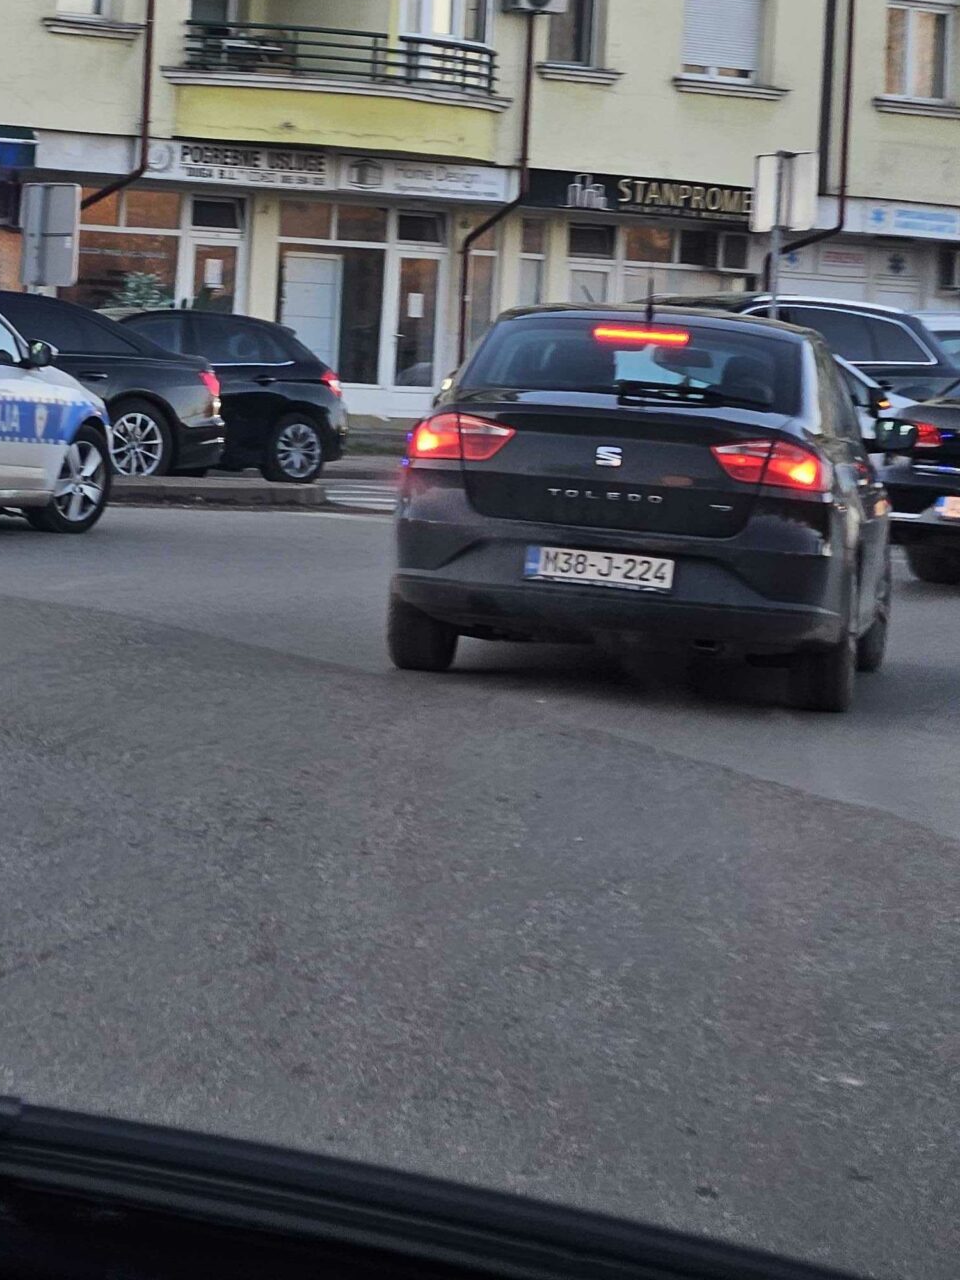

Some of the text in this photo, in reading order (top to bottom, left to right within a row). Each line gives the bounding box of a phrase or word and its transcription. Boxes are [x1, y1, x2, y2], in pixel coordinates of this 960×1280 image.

[181, 145, 326, 172] POGREBNE USLUGE
[547, 487, 664, 504] TOLEDO
[543, 550, 667, 584] M38-J-224
